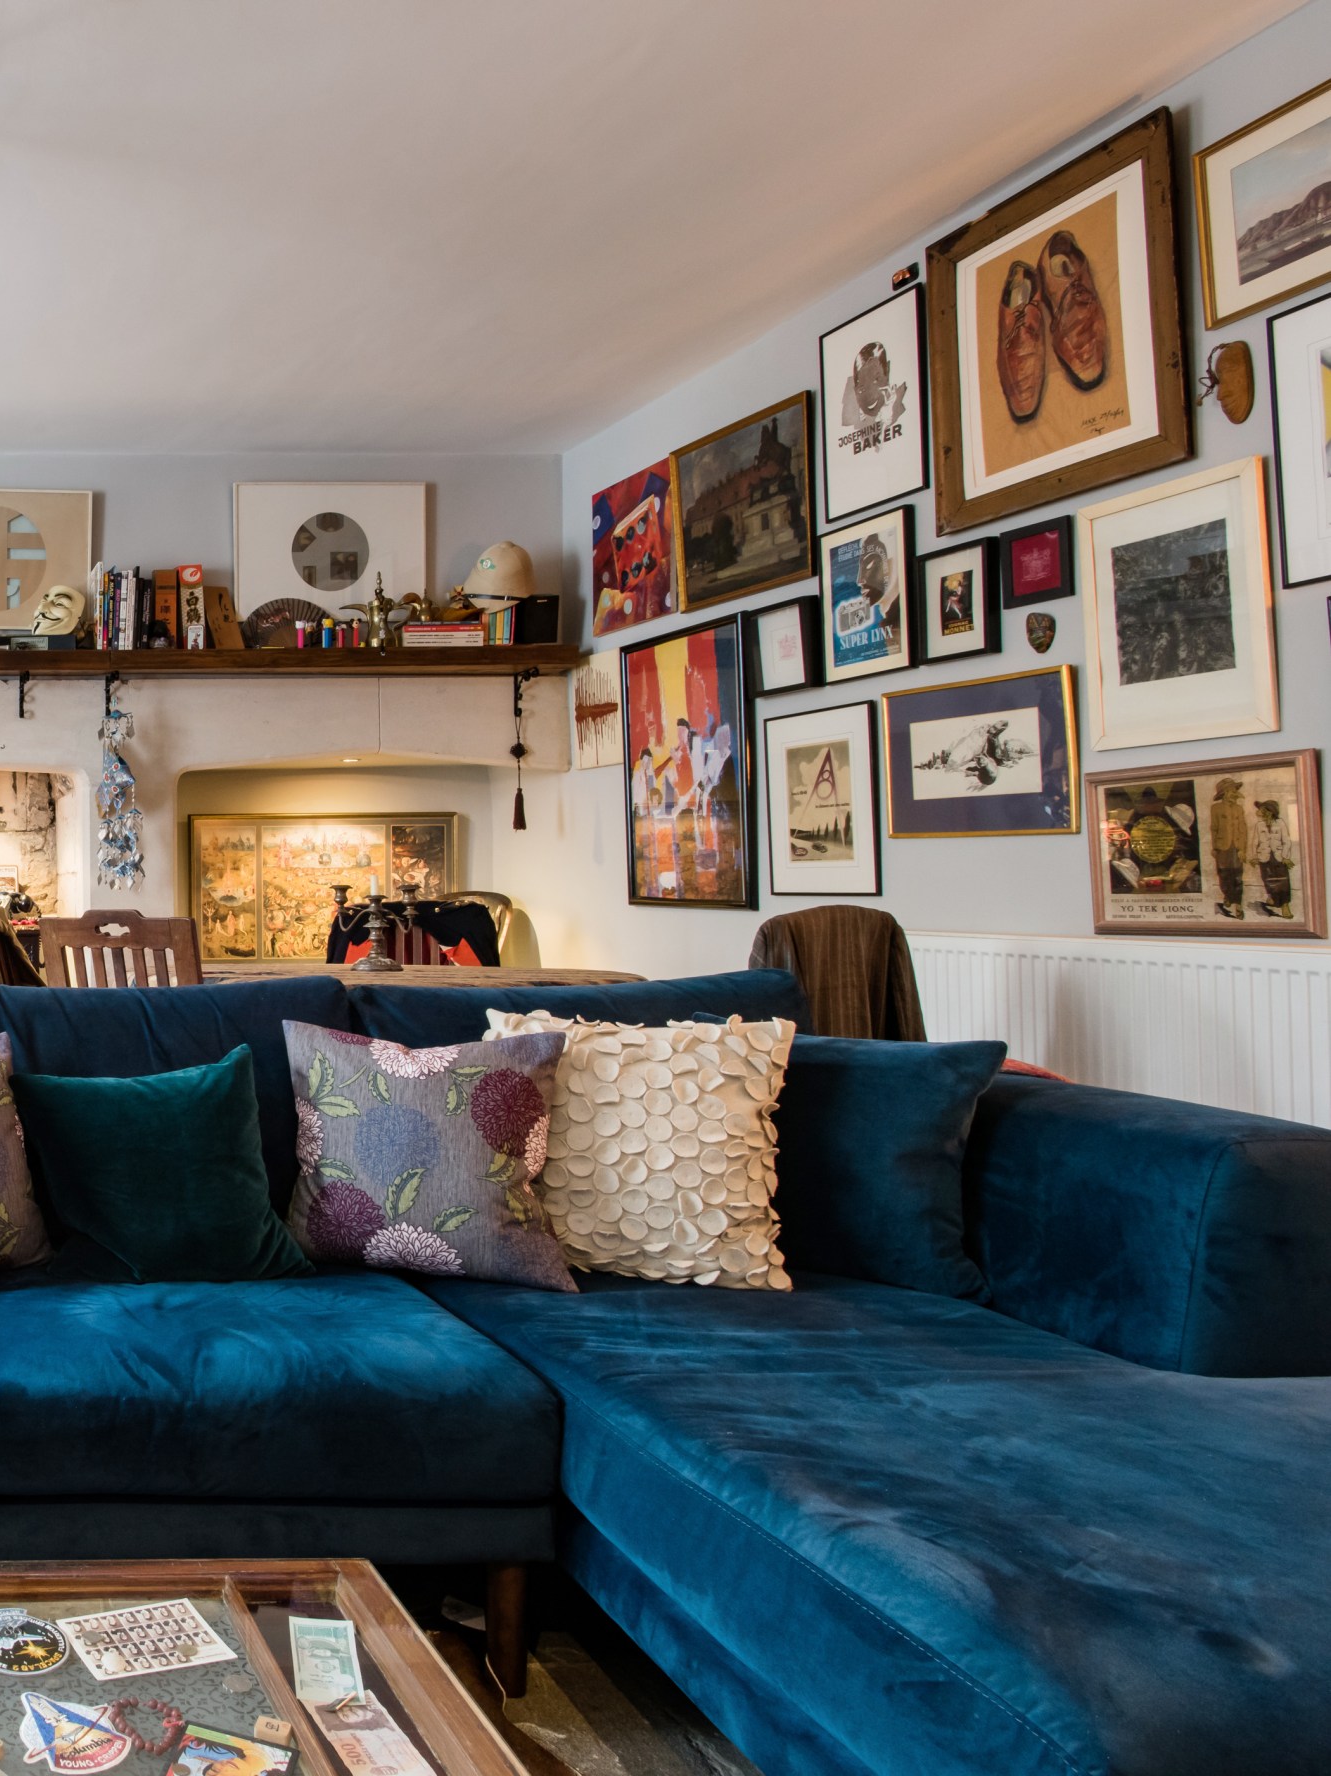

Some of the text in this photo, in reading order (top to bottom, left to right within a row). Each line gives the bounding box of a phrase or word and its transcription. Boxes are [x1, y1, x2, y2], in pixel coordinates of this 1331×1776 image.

[838, 420, 882, 448] JOSEPHINE
[853, 424, 902, 455] BAKER
[839, 625, 893, 650] SUPER LYNX
[1162, 905, 1194, 913] LIONG
[20, 1652, 63, 1671] SPACELAB
[59, 1737, 114, 1760] Columbia
[341, 1743, 367, 1765] 500
[59, 1758, 95, 1768] YOUNG
